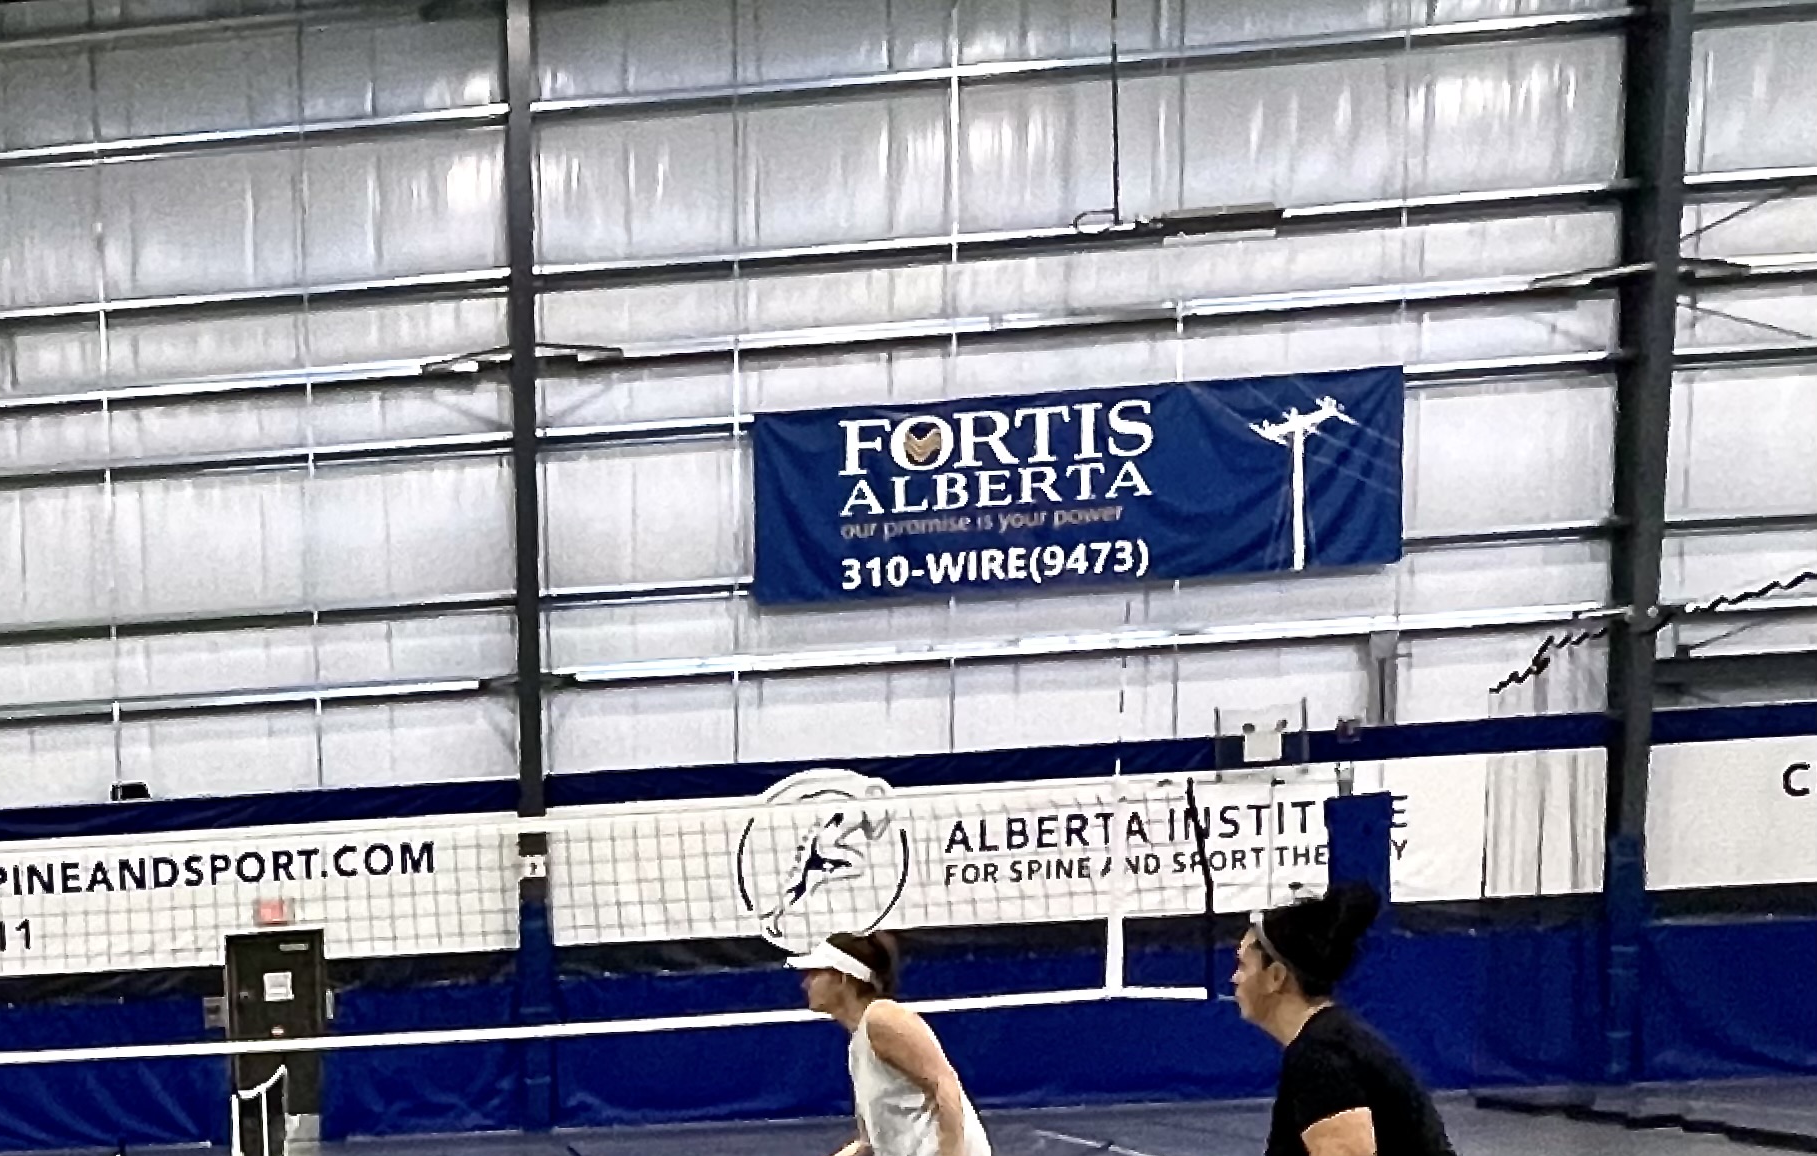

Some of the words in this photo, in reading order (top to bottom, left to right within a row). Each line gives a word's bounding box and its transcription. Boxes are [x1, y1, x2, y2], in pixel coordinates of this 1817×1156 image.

[838, 399, 1154, 477] FORTIS
[839, 460, 1154, 517] ALBERTA
[841, 521, 877, 540] our
[884, 514, 971, 541] promise
[977, 514, 993, 531] is
[999, 510, 1046, 533] your
[1052, 505, 1124, 530] power
[840, 537, 1150, 590] 310-WIRE(9473)
[944, 808, 1151, 854] ALBERTA
[1168, 794, 1409, 842] INSTITE
[944, 862, 999, 886] FOR
[1008, 855, 1091, 883] SPINE
[1171, 846, 1266, 874] SPORT
[1274, 838, 1408, 867] THEY
